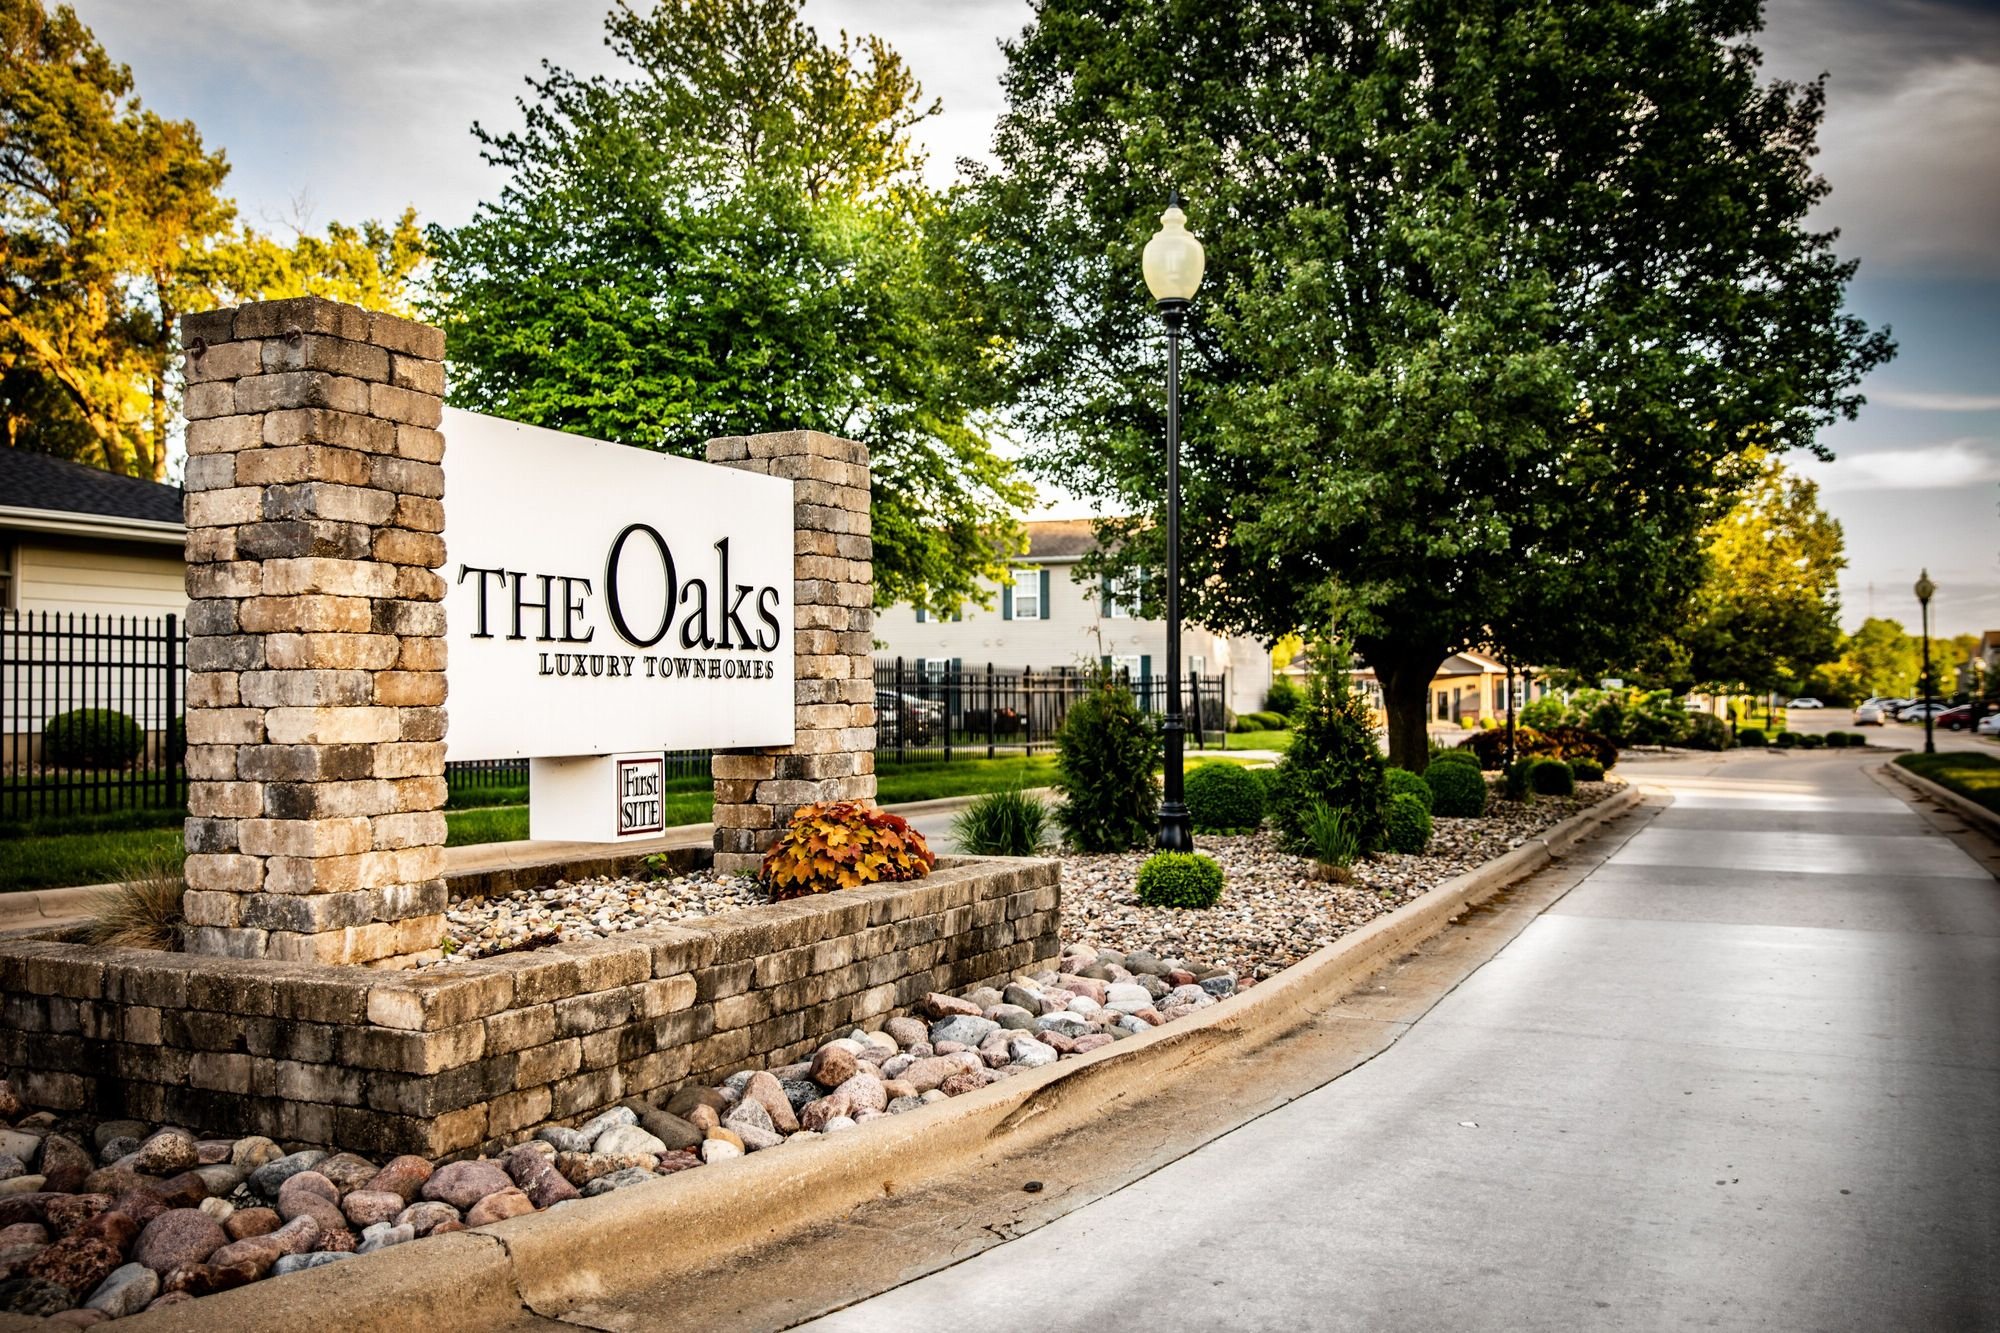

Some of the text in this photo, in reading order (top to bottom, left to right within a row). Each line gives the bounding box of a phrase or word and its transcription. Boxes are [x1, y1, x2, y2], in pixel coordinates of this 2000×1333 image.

[457, 523, 780, 652] THE Oaks
[539, 653, 775, 679] LUXURY TOWNHOMES
[623, 766, 659, 797] First
[623, 800, 660, 828] SITE
